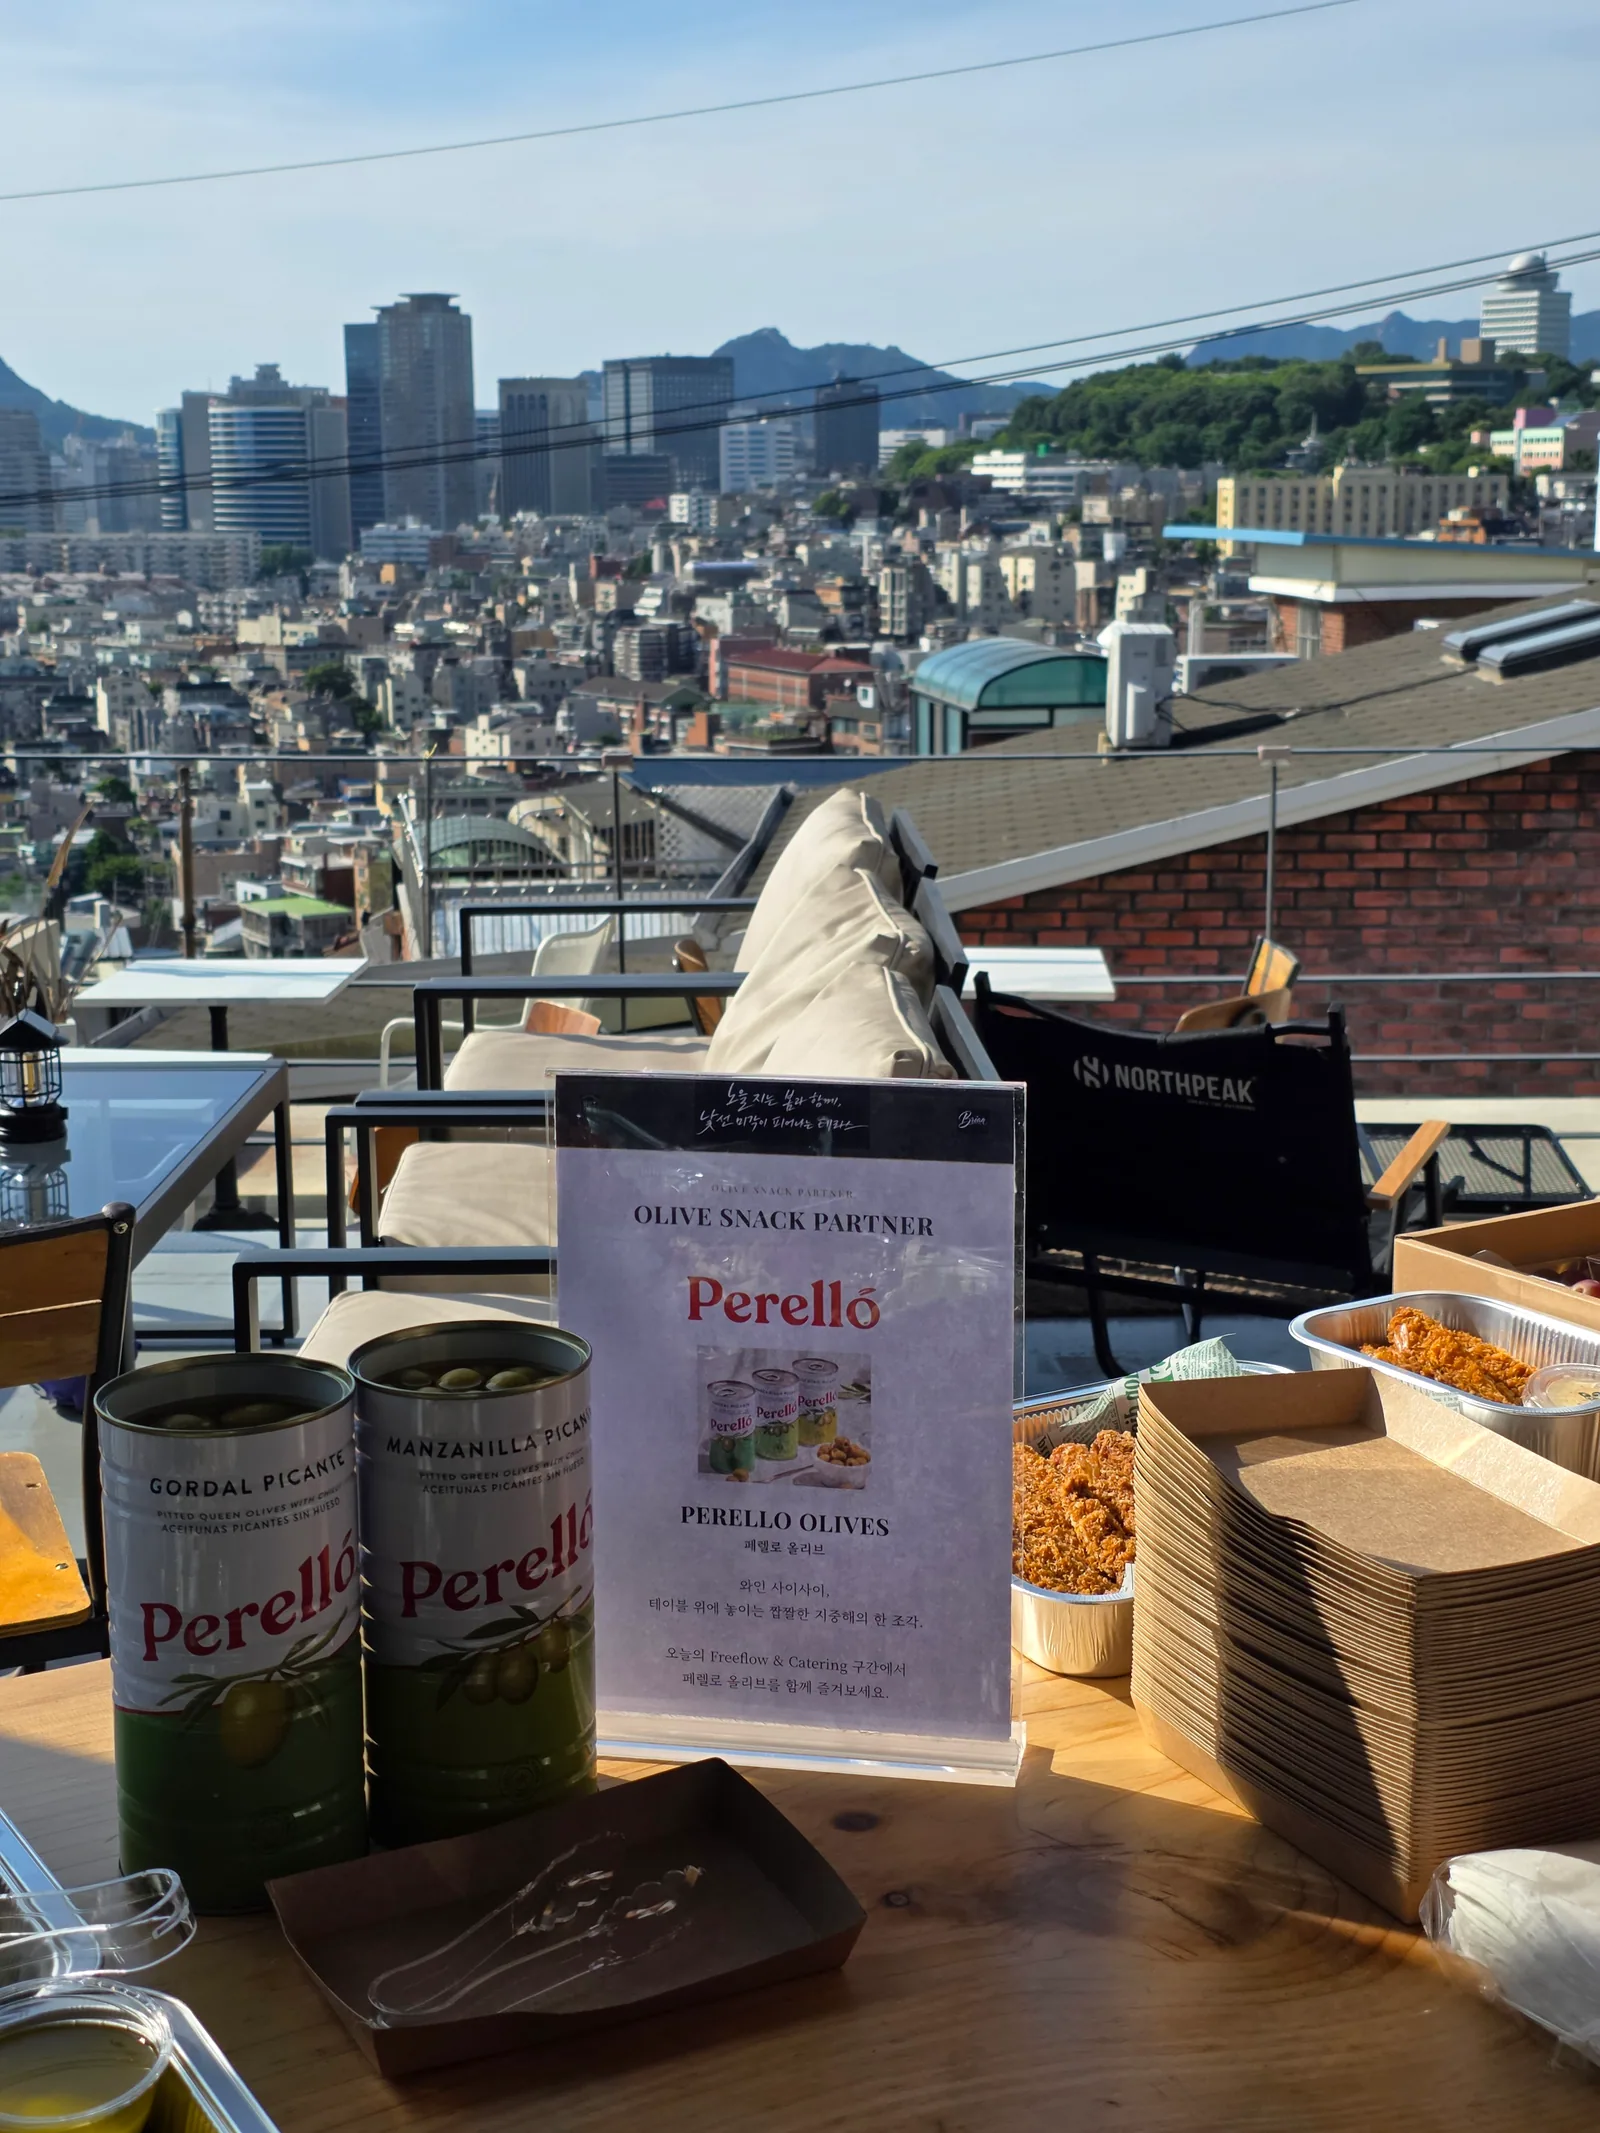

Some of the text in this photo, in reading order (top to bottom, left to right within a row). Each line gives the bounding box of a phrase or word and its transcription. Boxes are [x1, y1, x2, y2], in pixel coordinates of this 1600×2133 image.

[1114, 1064, 1254, 1104] NORTHPEAK
[711, 1183, 854, 1199] OLIVE SNACK PARTNER
[634, 1205, 934, 1236] OLIVE SNACK PARTNER
[687, 1275, 881, 1330] Perelló
[386, 1435, 538, 1459] MANZANILLA
[150, 1449, 345, 1498] GORDAL PICANTE
[419, 1471, 457, 1482] PITTED
[461, 1471, 499, 1481] GREEN
[503, 1463, 540, 1478] OLIVES
[422, 1456, 585, 1495] ACEITUNAS PICANTES SIN HUESO
[156, 1510, 195, 1521] PITTED
[200, 1511, 241, 1522] QUEEN
[245, 1503, 286, 1518] OLIVES
[290, 1495, 315, 1509] WITH
[161, 1497, 341, 1535] ACEITUNAS PICANTES SIN HUESO
[681, 1505, 890, 1537] PERELLO OLIVES
[744, 1539, 826, 1556] 페렐로 올리브
[140, 1528, 355, 1662] Perelló
[739, 1578, 830, 1598] 와인 사이사이,
[649, 1598, 923, 1629] 테이블 위에 놓이는 짭짤한 지중해의 한 조각.
[665, 1647, 907, 1677] 오늘의 Freeflow & Catering 구간에서
[682, 1672, 889, 1700] 페렐로 올리브를 함께 즐겨보세요.
